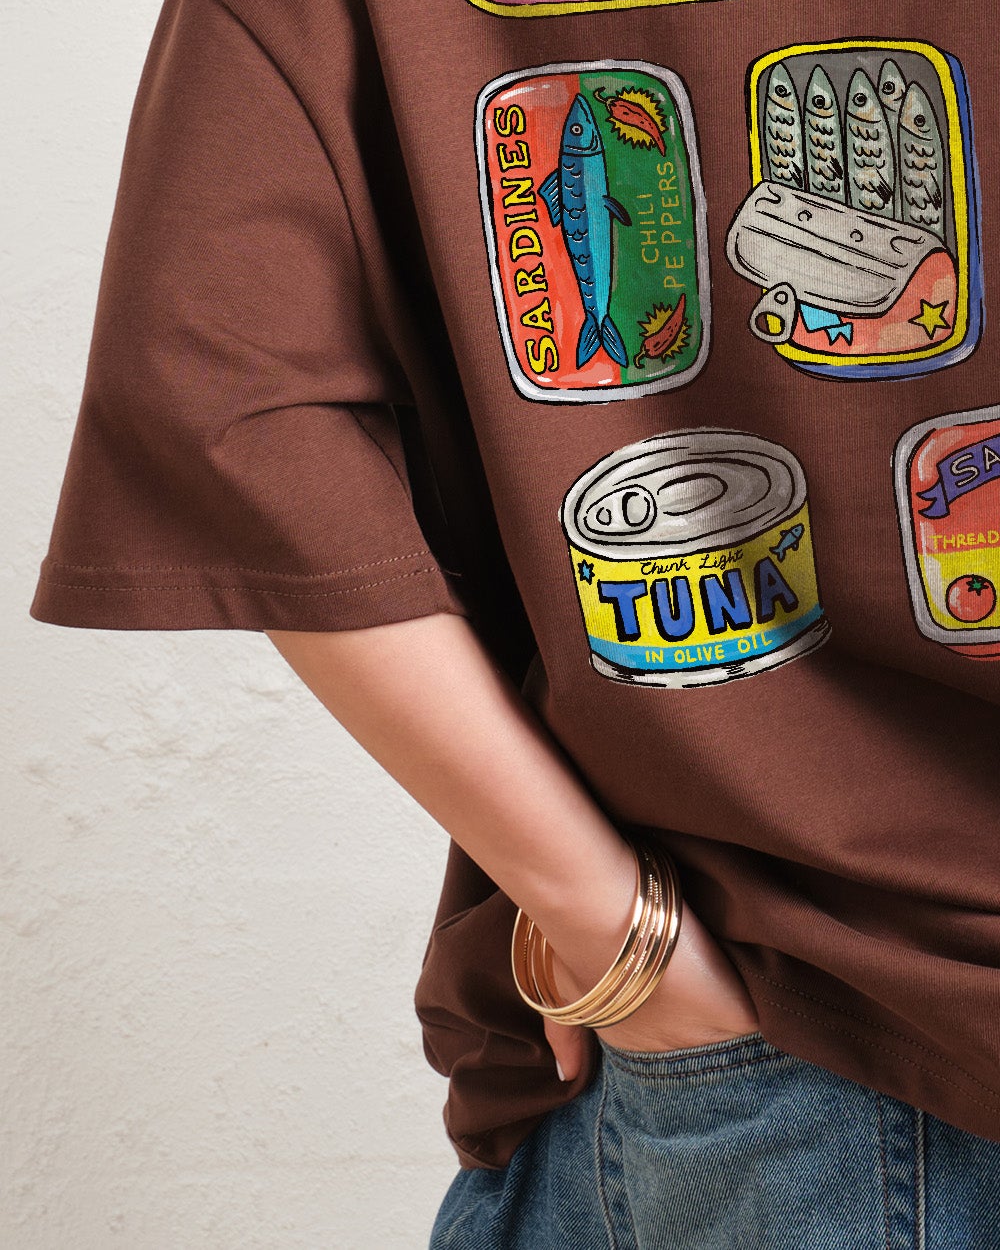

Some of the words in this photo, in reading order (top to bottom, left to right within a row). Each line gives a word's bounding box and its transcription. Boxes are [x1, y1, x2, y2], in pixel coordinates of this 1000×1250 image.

[493, 104, 560, 374] SARDINES
[637, 194, 659, 264] CHILI
[657, 161, 686, 289] PEPPERS
[699, 549, 744, 571] Light
[929, 531, 1000, 550] THREAD
[598, 556, 799, 643] TUNA
[645, 650, 664, 664] IN
[674, 642, 726, 664] OLIVE
[737, 632, 773, 654] OIL
